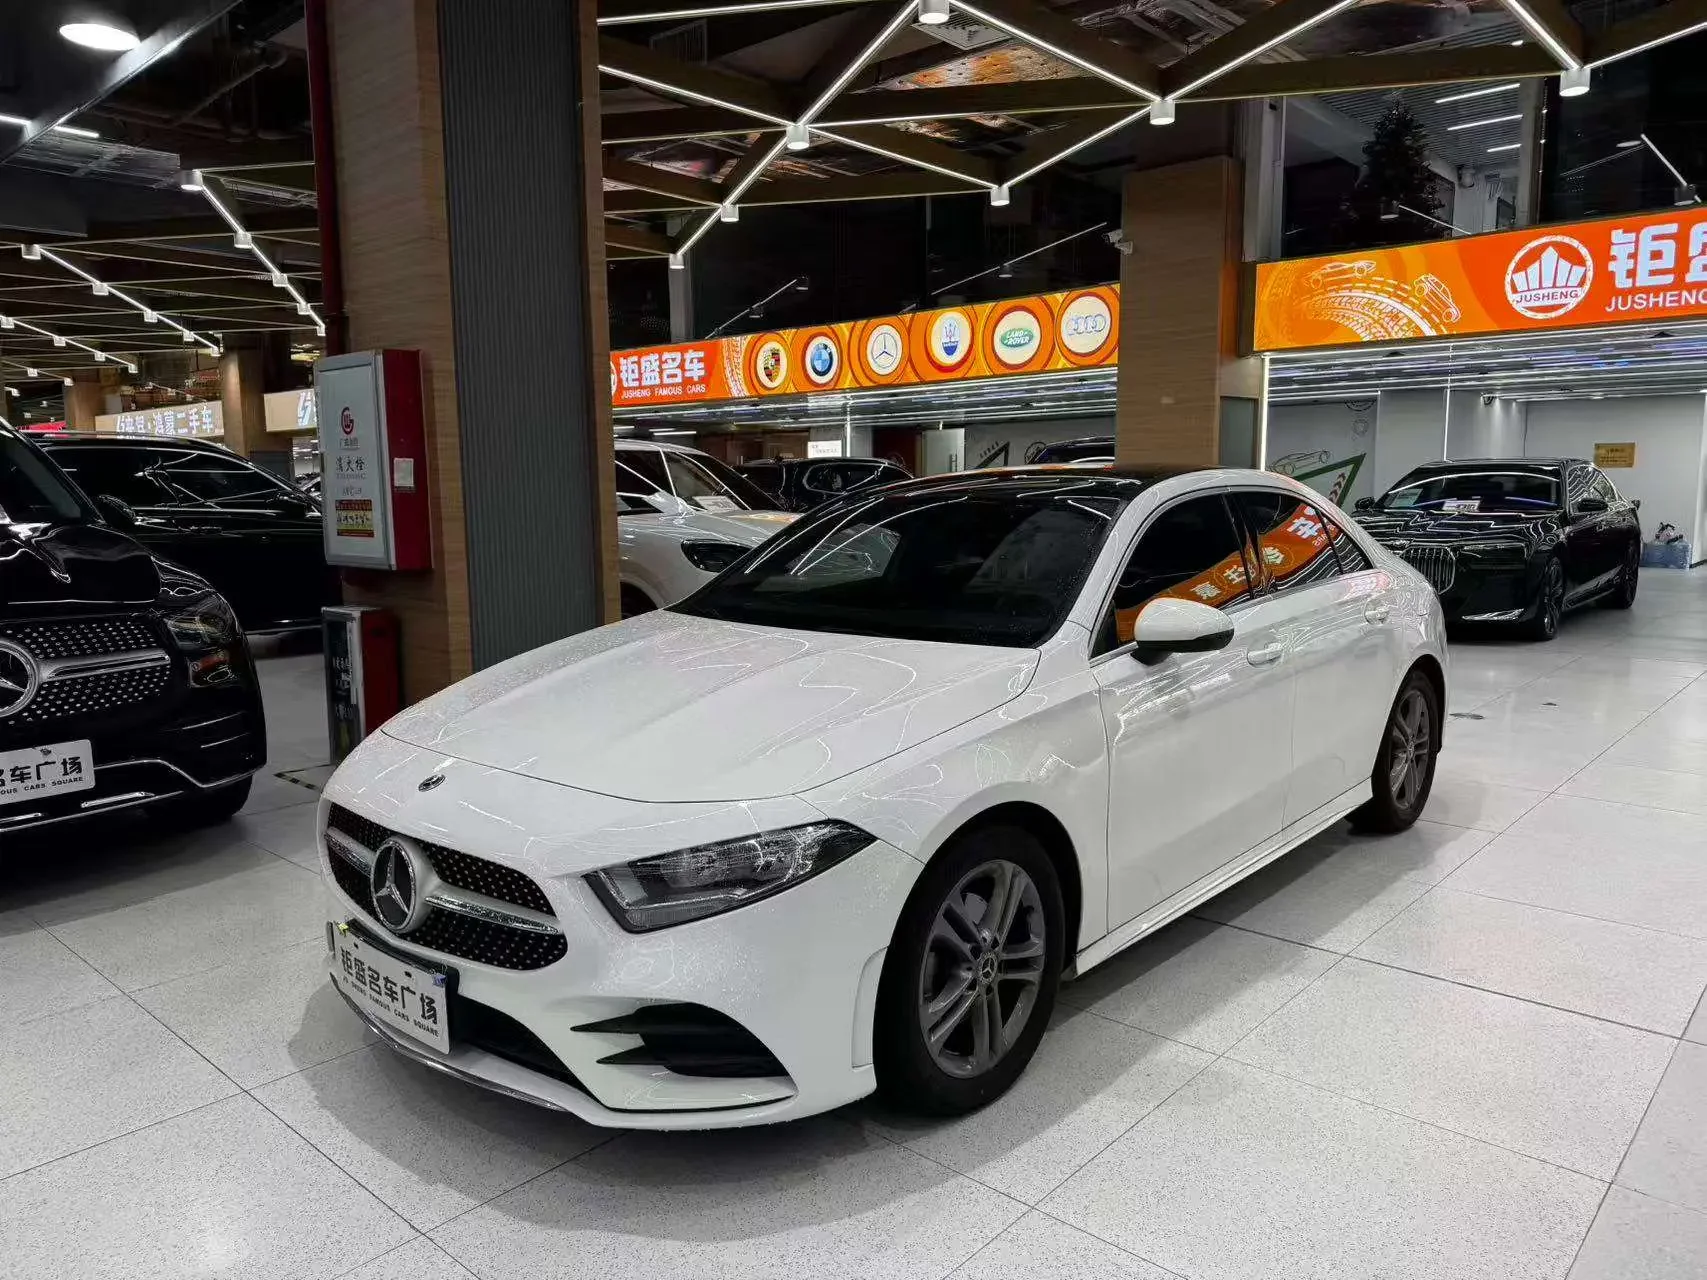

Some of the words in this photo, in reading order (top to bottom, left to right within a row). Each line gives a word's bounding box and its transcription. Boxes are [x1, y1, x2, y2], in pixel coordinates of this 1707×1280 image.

[1515, 289, 1579, 304] JUSHENG
[620, 349, 704, 387] 钜盛名车
[622, 388, 651, 399] JUSHENG
[655, 386, 682, 396] FAMOUS
[687, 384, 706, 393] CARS
[0, 756, 82, 787] 车广场
[341, 946, 437, 1024] 钜盛名车广场
